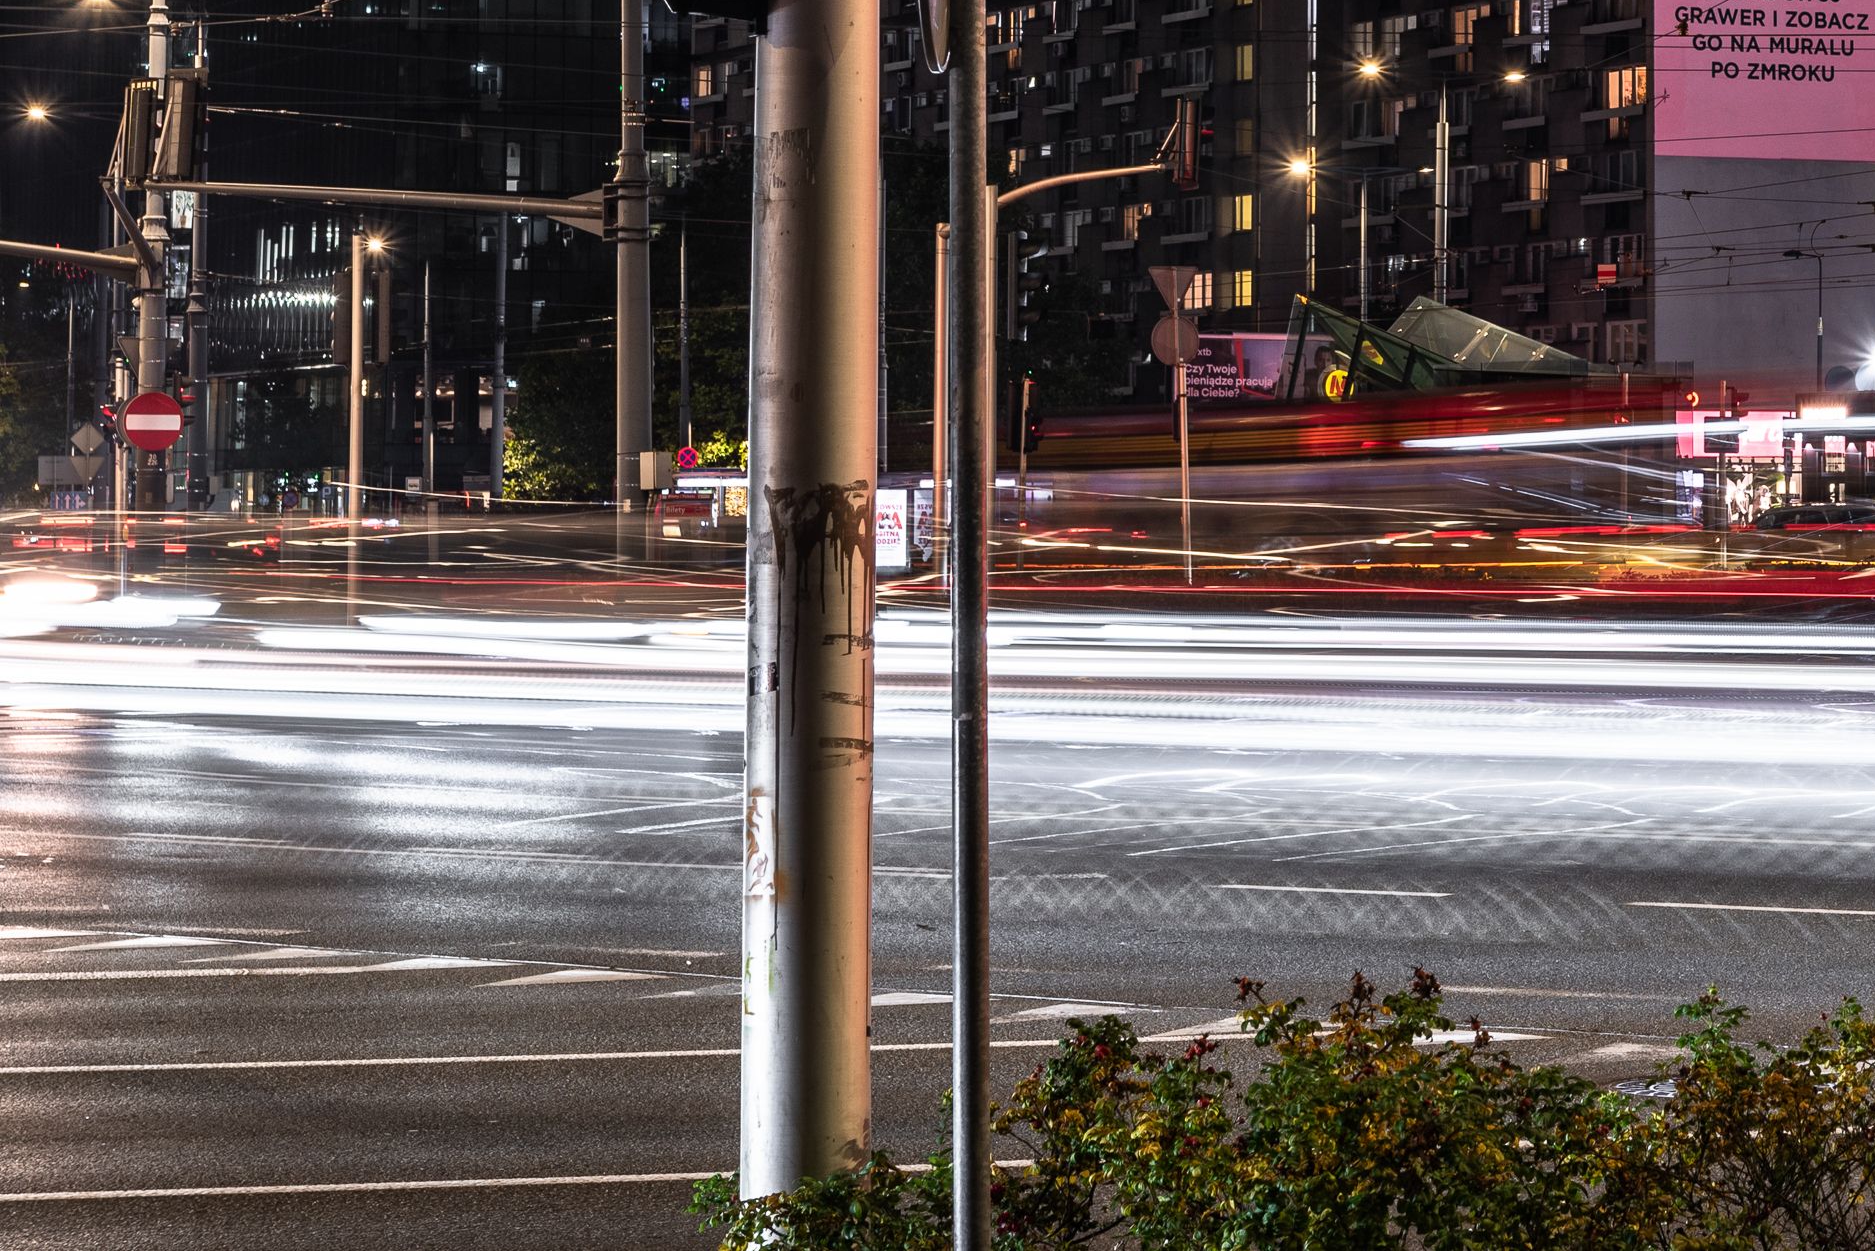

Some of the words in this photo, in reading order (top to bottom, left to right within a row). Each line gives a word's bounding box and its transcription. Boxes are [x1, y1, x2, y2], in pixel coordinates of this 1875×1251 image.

[1674, 5, 1766, 28] GRAWER
[1772, 9, 1778, 27] I
[1784, 9, 1870, 32] ZOBACZ
[1692, 33, 1724, 54] GO
[1730, 34, 1761, 54] NA
[1768, 35, 1856, 57] MURALU
[1710, 61, 1740, 80] PO
[1746, 61, 1836, 83] ZMROKU
[1185, 363, 1204, 375] Czy
[1206, 362, 1237, 375] Twoje
[1185, 375, 1234, 387] pieniądze
[1235, 377, 1273, 389] pracują
[1185, 387, 1200, 398] dla
[1201, 387, 1240, 398] Ciebie?
